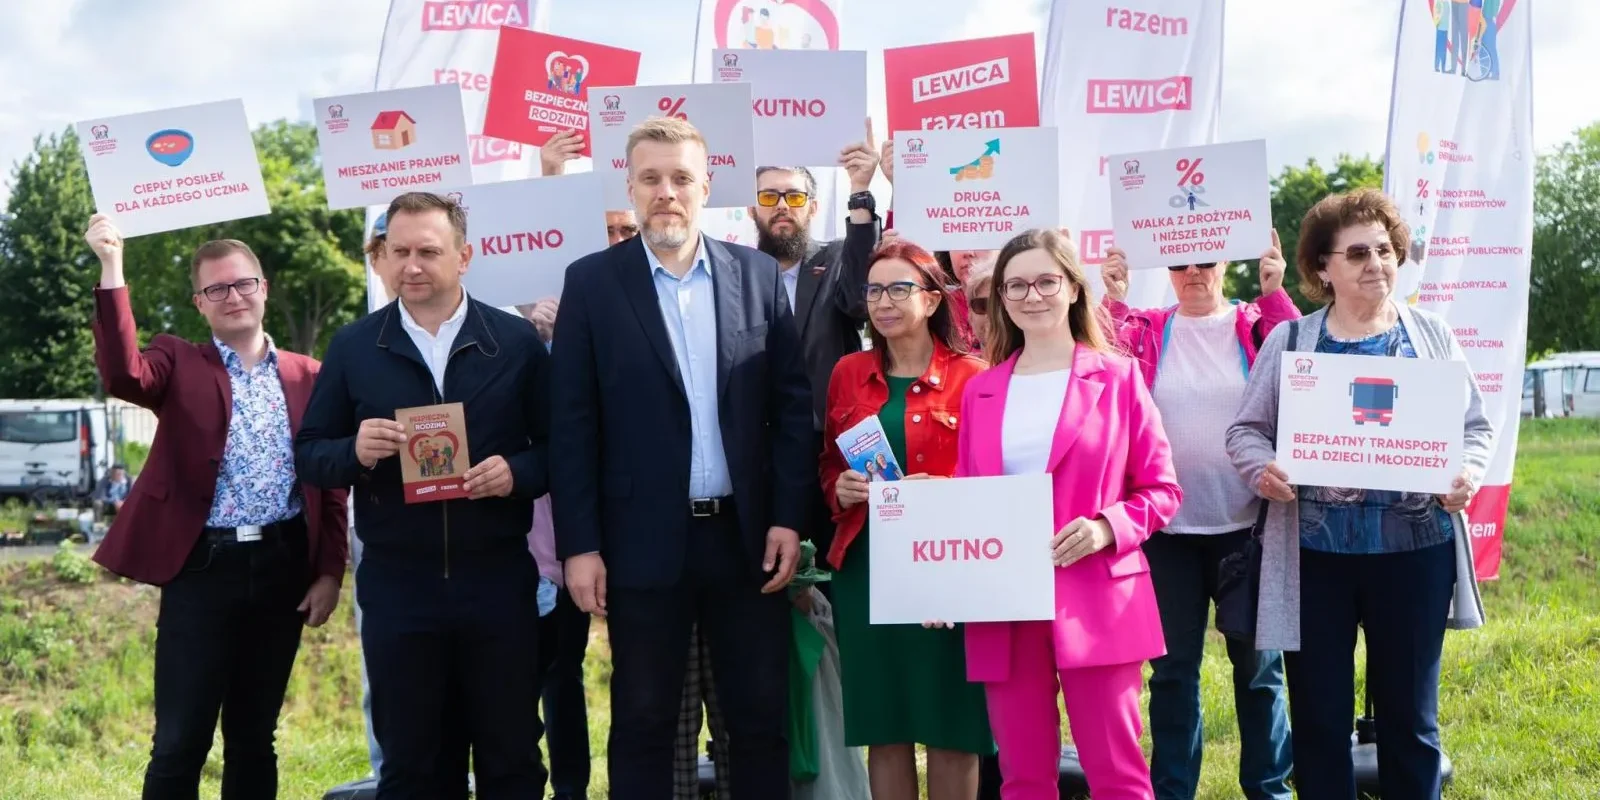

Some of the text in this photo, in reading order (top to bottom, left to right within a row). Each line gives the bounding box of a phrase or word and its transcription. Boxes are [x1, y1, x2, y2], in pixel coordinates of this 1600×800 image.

[428, 4, 523, 26] LEWICA
[1106, 7, 1188, 36] razem
[434, 67, 488, 91] raze
[918, 62, 1004, 98] LEWICA
[524, 90, 590, 112] BEZPIECZN
[1093, 81, 1187, 108] LEWICA
[530, 108, 585, 128] RODZINA
[752, 98, 826, 118] KUTNO
[338, 154, 460, 178] MIESZKANIE PRAWEM
[133, 171, 225, 194] CIEPŁY POSIŁEK
[361, 172, 442, 190] NIE TOWAREM
[115, 182, 249, 213] DLA KAŻDEGO UCZNIA
[954, 191, 1002, 202] DRUGA
[926, 206, 1030, 218] WALORYZACJA
[1132, 209, 1252, 230] WALKA Z DROŻYZNĄ
[942, 221, 1013, 233] EMERYTUR
[1153, 226, 1231, 242] I NIŻSZE RATY
[481, 229, 564, 256] KUTNO
[1160, 240, 1226, 255] KREDYTÓW
[1441, 281, 1507, 290] WALORYZACJA
[415, 422, 447, 431] RODZINA
[1294, 433, 1447, 452] BEZPŁATNY TRANSPORT
[1293, 449, 1448, 469] DLA DZIECI I MŁODZIEŻY
[913, 538, 1003, 562] KUTNO
